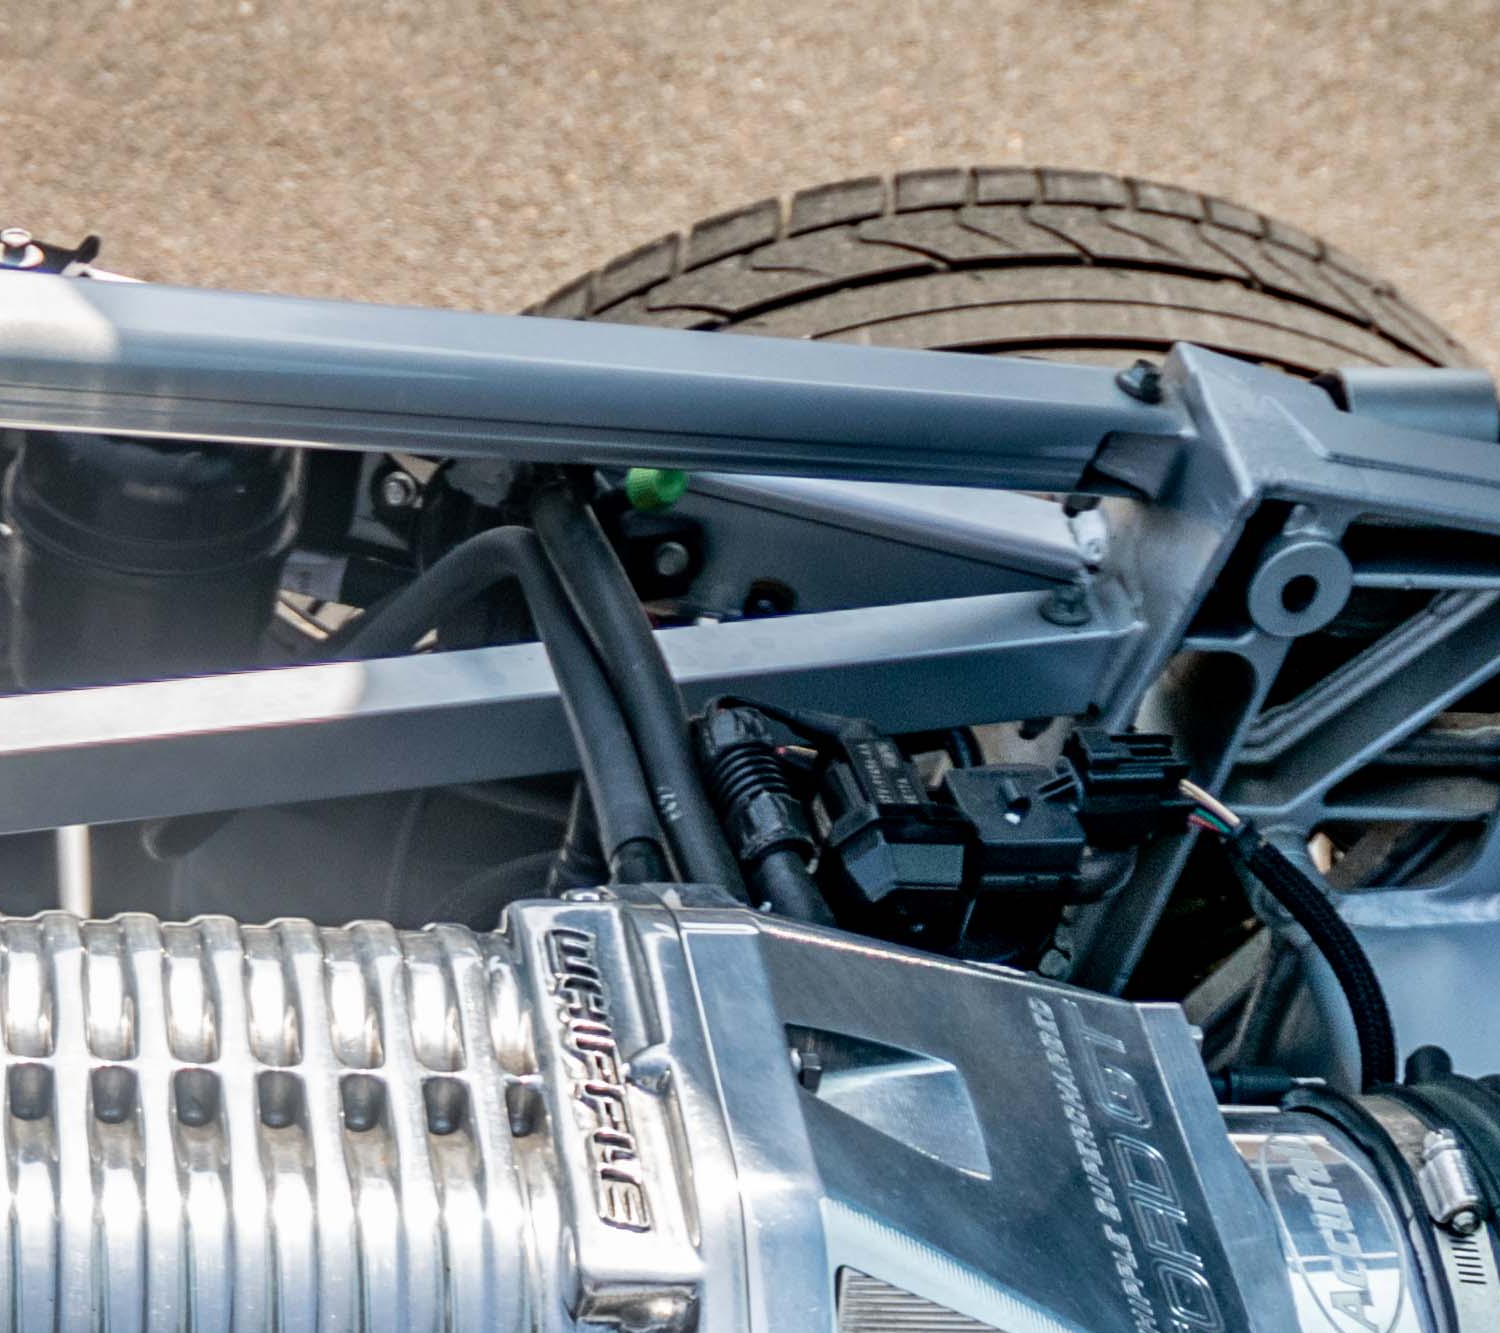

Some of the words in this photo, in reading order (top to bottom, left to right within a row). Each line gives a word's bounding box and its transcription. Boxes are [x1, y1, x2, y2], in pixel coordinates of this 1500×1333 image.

[545, 927, 652, 1234] WHIPPLE
[1027, 995, 1122, 1224] SUPERCHARGED
[1061, 997, 1153, 1129] GT
